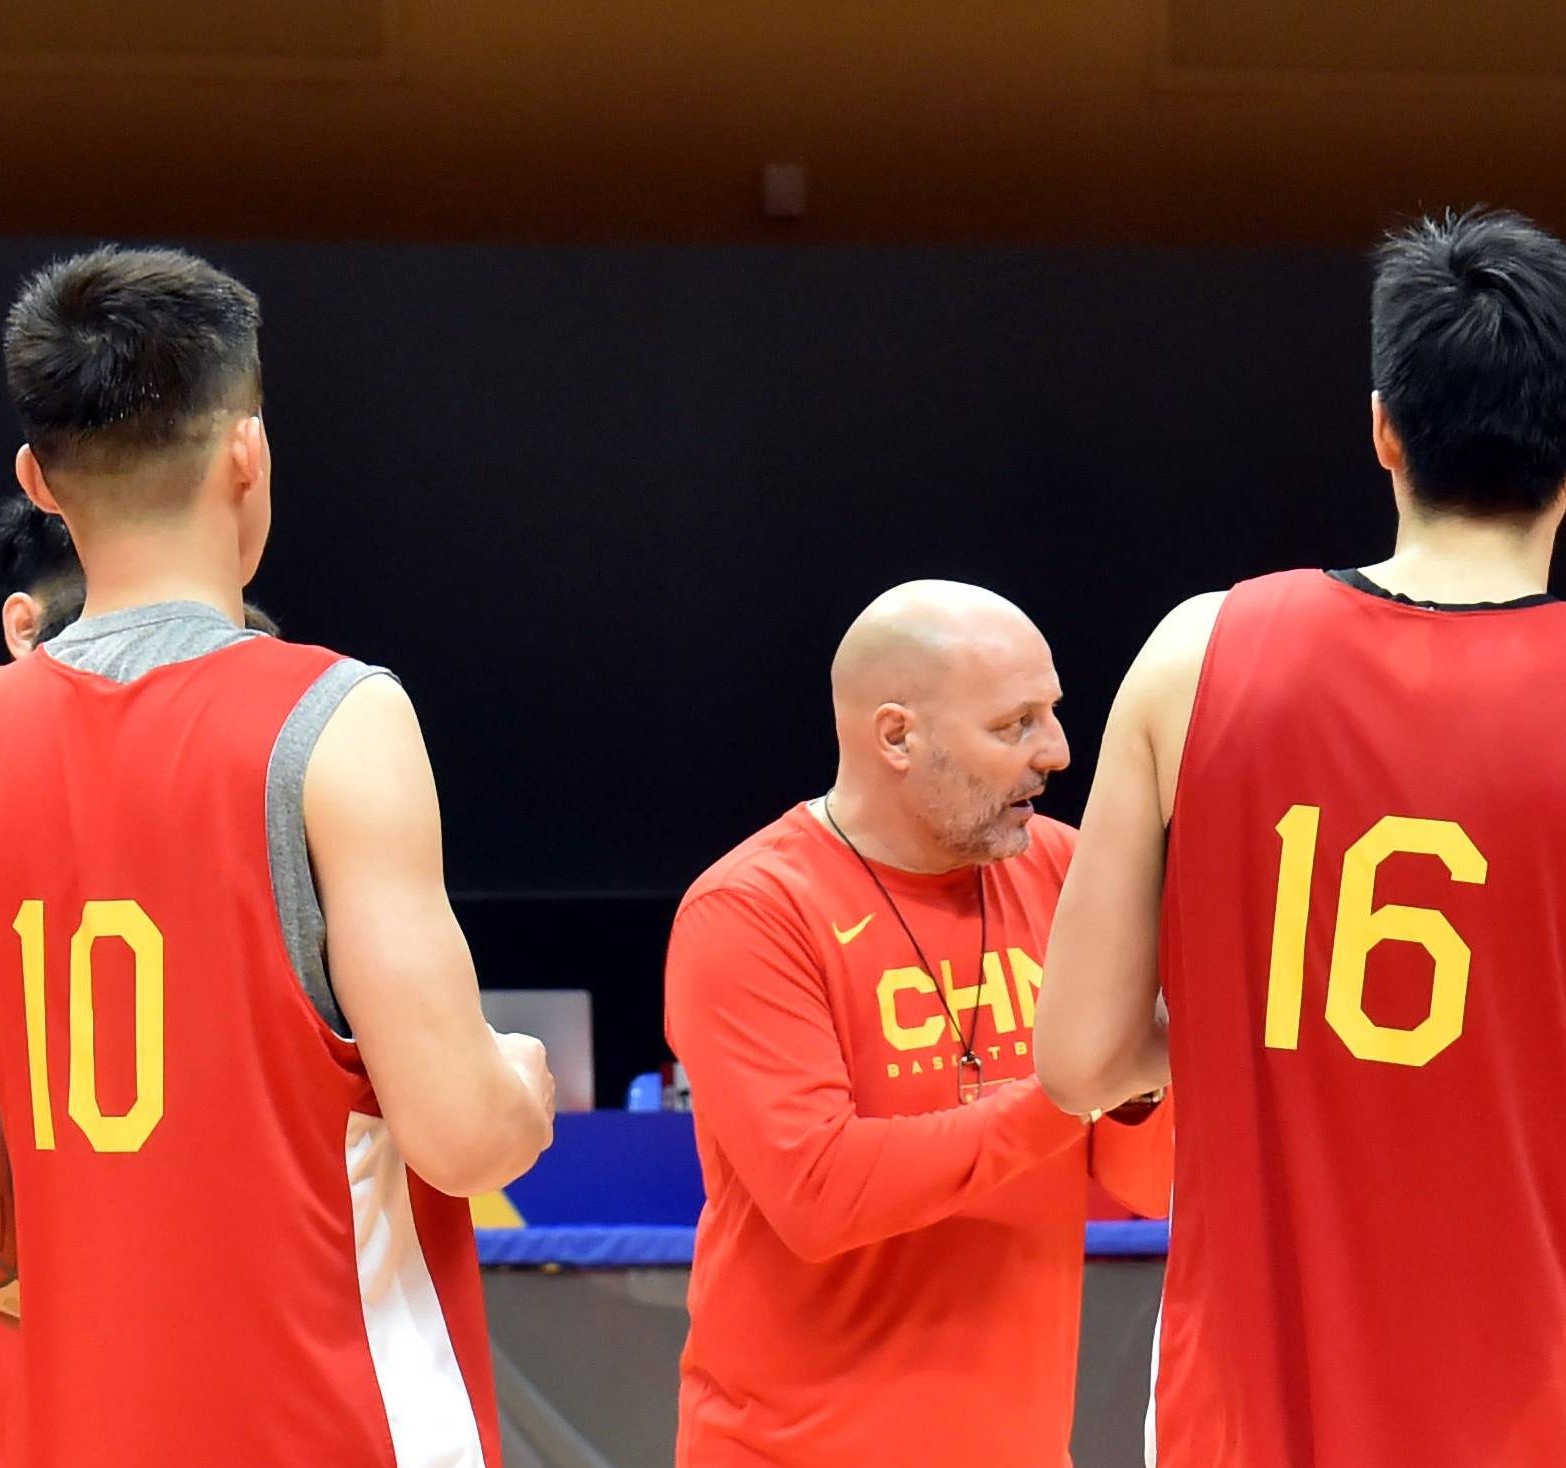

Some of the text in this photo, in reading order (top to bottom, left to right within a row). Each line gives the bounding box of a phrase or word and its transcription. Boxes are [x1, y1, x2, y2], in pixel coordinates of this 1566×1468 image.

[12, 898, 164, 1152] 10
[876, 947, 1043, 1051] CHN
[1264, 803, 1488, 1067] 16
